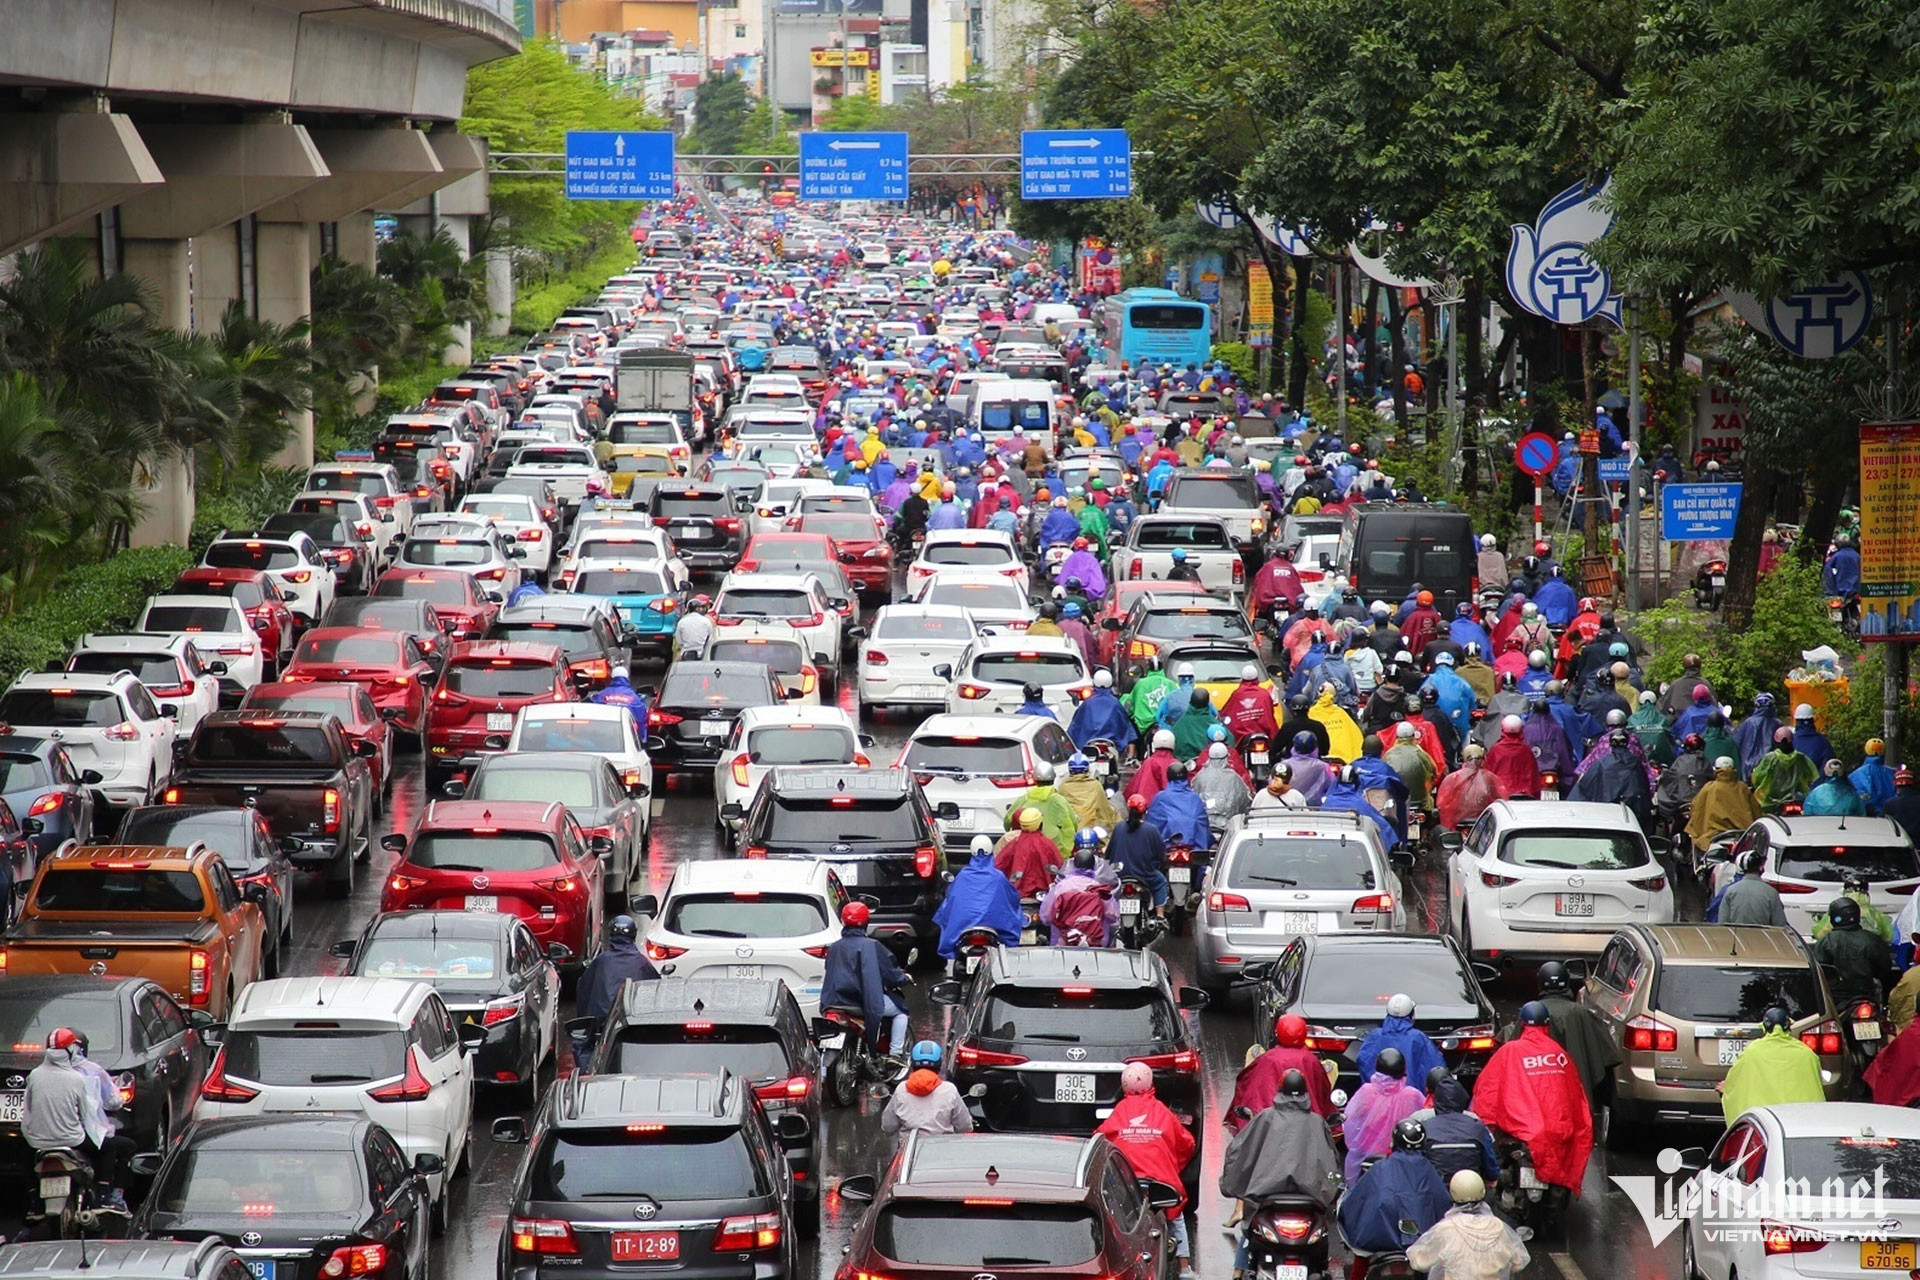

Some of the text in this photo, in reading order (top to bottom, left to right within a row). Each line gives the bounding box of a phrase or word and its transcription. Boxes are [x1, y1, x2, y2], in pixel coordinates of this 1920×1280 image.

[569, 156, 581, 166] NÚT
[583, 158, 598, 166] GIAO
[600, 157, 613, 166] NGÃ
[627, 155, 636, 166] SỞ
[805, 156, 847, 167] ĐƯỜNG LÁNG
[1025, 155, 1047, 165] ĐƯỜNG
[1050, 154, 1075, 165] TRƯỜNG
[1104, 156, 1126, 164] 0.7 km
[569, 169, 581, 179] NÚT
[600, 170, 605, 179] Ô
[607, 171, 619, 181] CHỢ
[649, 172, 671, 180] 2.5 km
[805, 170, 866, 180] NÚT GIAO CẦU GIẤY
[886, 172, 902, 180] 5 km
[1026, 169, 1038, 179] NÚT
[1040, 171, 1054, 179] GIAO
[1056, 169, 1070, 178] NGÃ
[1082, 170, 1099, 180] VỌNG
[1109, 170, 1126, 178] 3 km
[569, 184, 582, 193] VĂN
[601, 183, 617, 193] QUỐC
[630, 183, 646, 193] GIÁM
[806, 184, 852, 194] CẦU NHẬT TÂN
[1026, 183, 1038, 193] CẦU
[1041, 183, 1056, 192] VĨNH
[1116, 183, 1126, 191] km
[1602, 461, 1616, 470] NGÕ
[1863, 456, 1899, 465] VIETBUILD
[1866, 469, 1889, 480] 23/3
[1673, 495, 1736, 509] BAN CHỈ HUY QUÂN SỰ
[1678, 509, 1732, 521] PHƯỜNG THƯỢNG ĐÌNH
[1568, 894, 1585, 903] 89A
[1563, 904, 1593, 914] 187.98
[1292, 912, 1310, 922] 29A
[736, 967, 754, 977] 30G
[1065, 1076, 1086, 1088] 30E
[1057, 1089, 1094, 1101] 886.33
[614, 1238, 676, 1254] TT-12-89
[1876, 1243, 1899, 1256] 30F
[1866, 1256, 1910, 1269] 670.96
